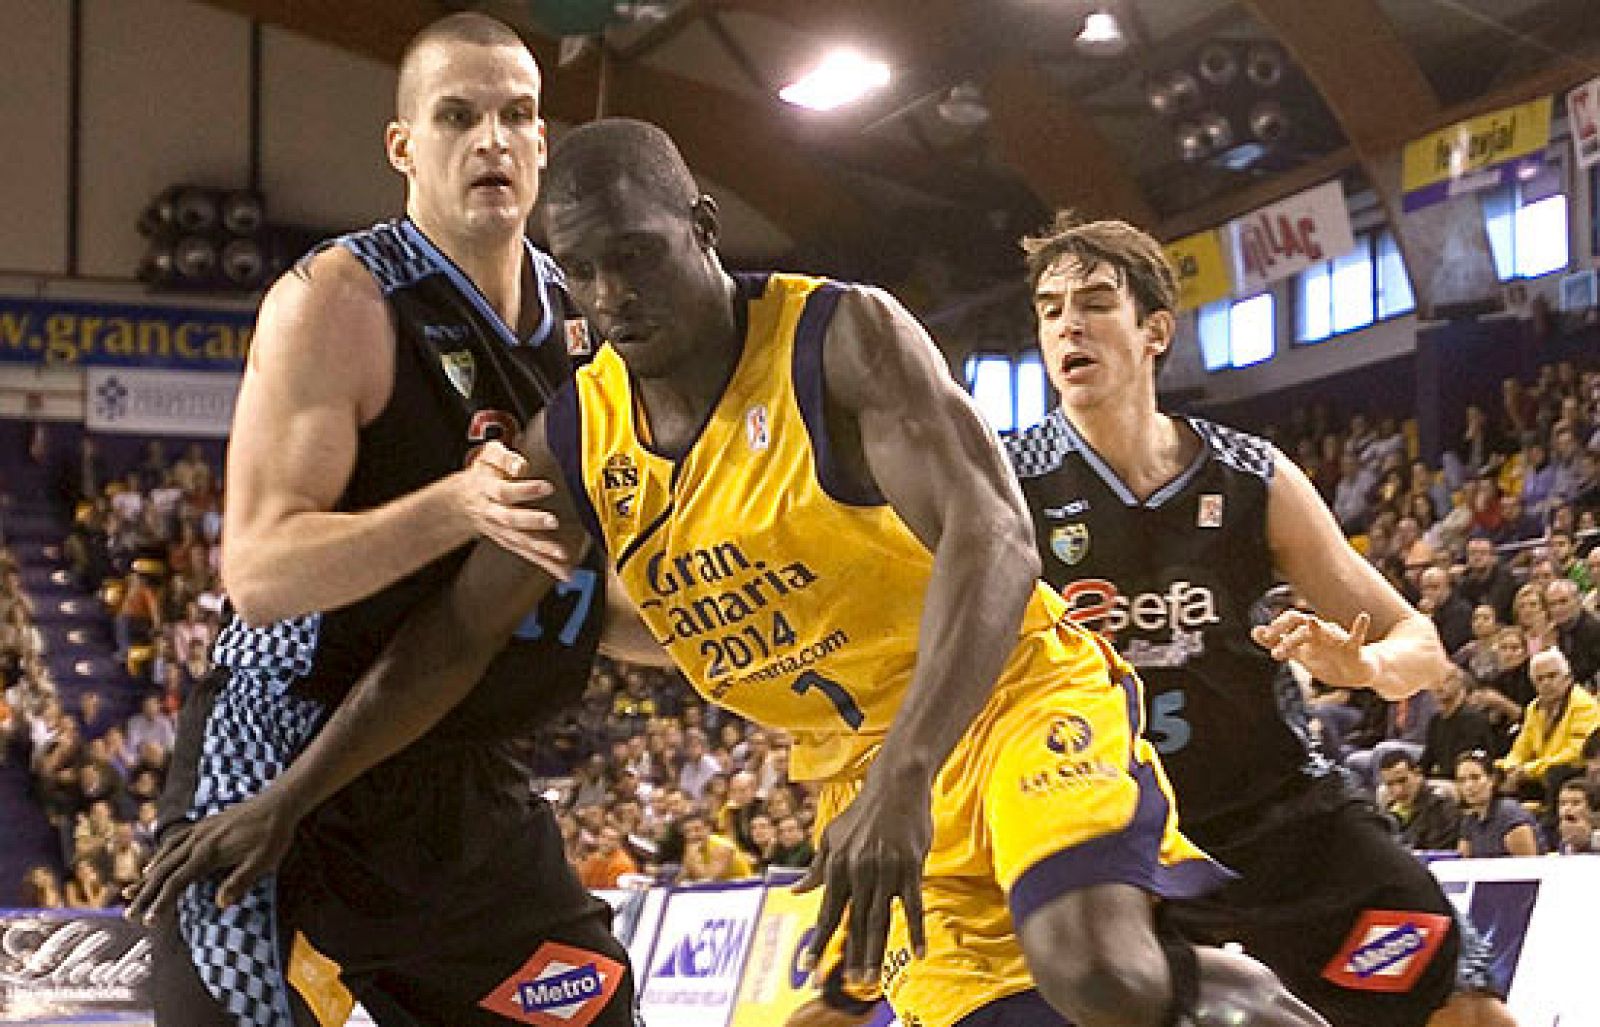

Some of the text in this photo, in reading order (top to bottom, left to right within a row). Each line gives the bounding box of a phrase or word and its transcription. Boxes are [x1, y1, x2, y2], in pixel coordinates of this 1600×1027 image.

[646, 541, 751, 597] Gran
[701, 611, 796, 679] 2014
[524, 976, 597, 1006] Metro
